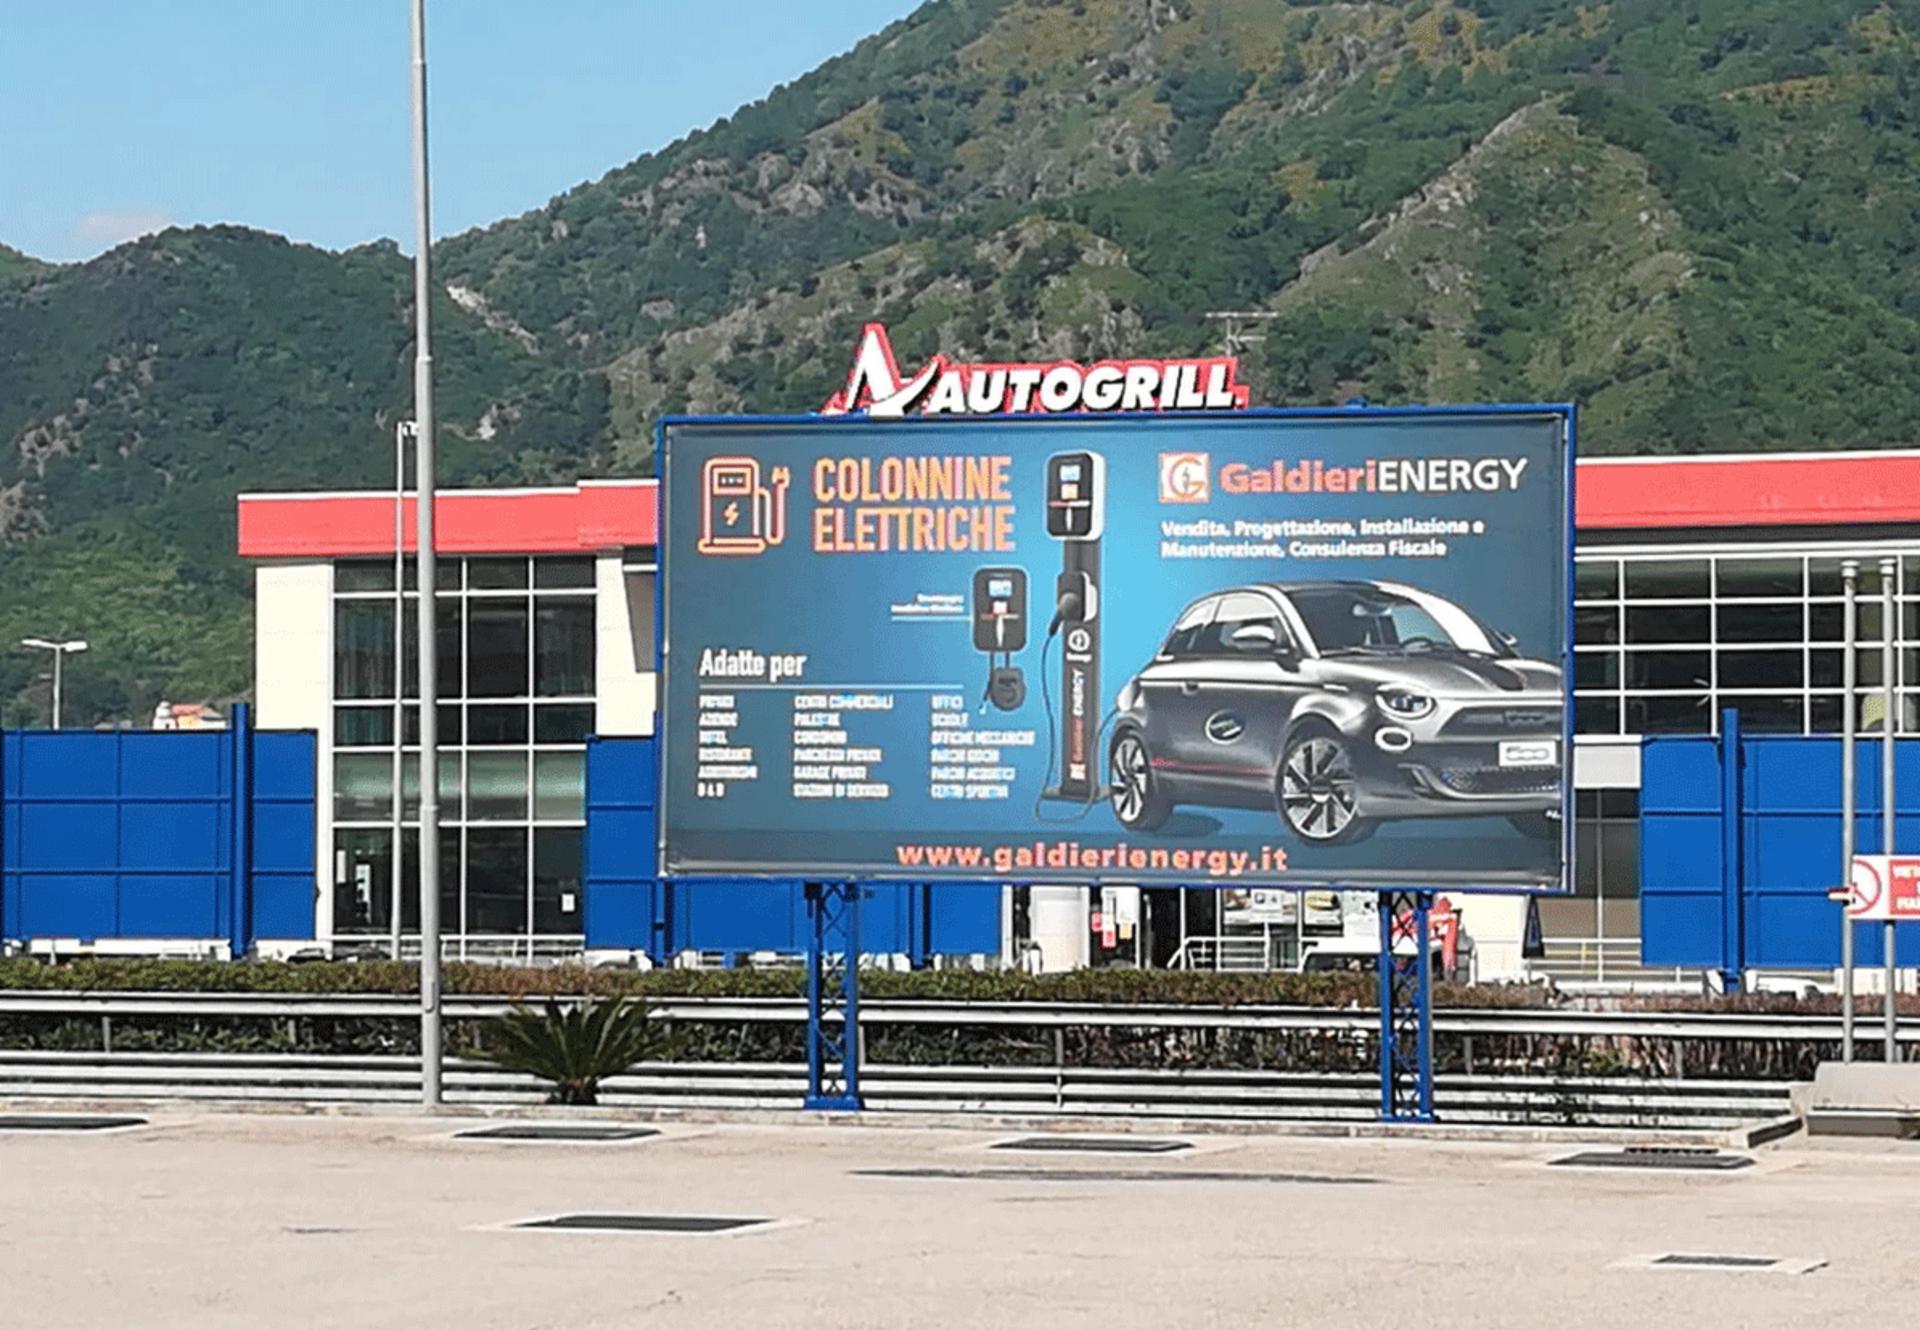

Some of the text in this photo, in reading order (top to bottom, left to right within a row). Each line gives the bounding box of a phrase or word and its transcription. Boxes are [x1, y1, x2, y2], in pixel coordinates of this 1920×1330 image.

[927, 361, 1238, 414] AUTOGRILL
[814, 455, 1012, 501] COLONNINE
[1219, 457, 1529, 493] GaldieriENERGY
[814, 505, 1016, 552] ELETTRICHE
[1360, 516, 1469, 535] Installazione
[1289, 538, 1386, 557] Consulenza
[1388, 537, 1447, 557] Fiscale
[699, 647, 808, 683] Adatte per
[896, 842, 1288, 875] www.galdierienergy.it
